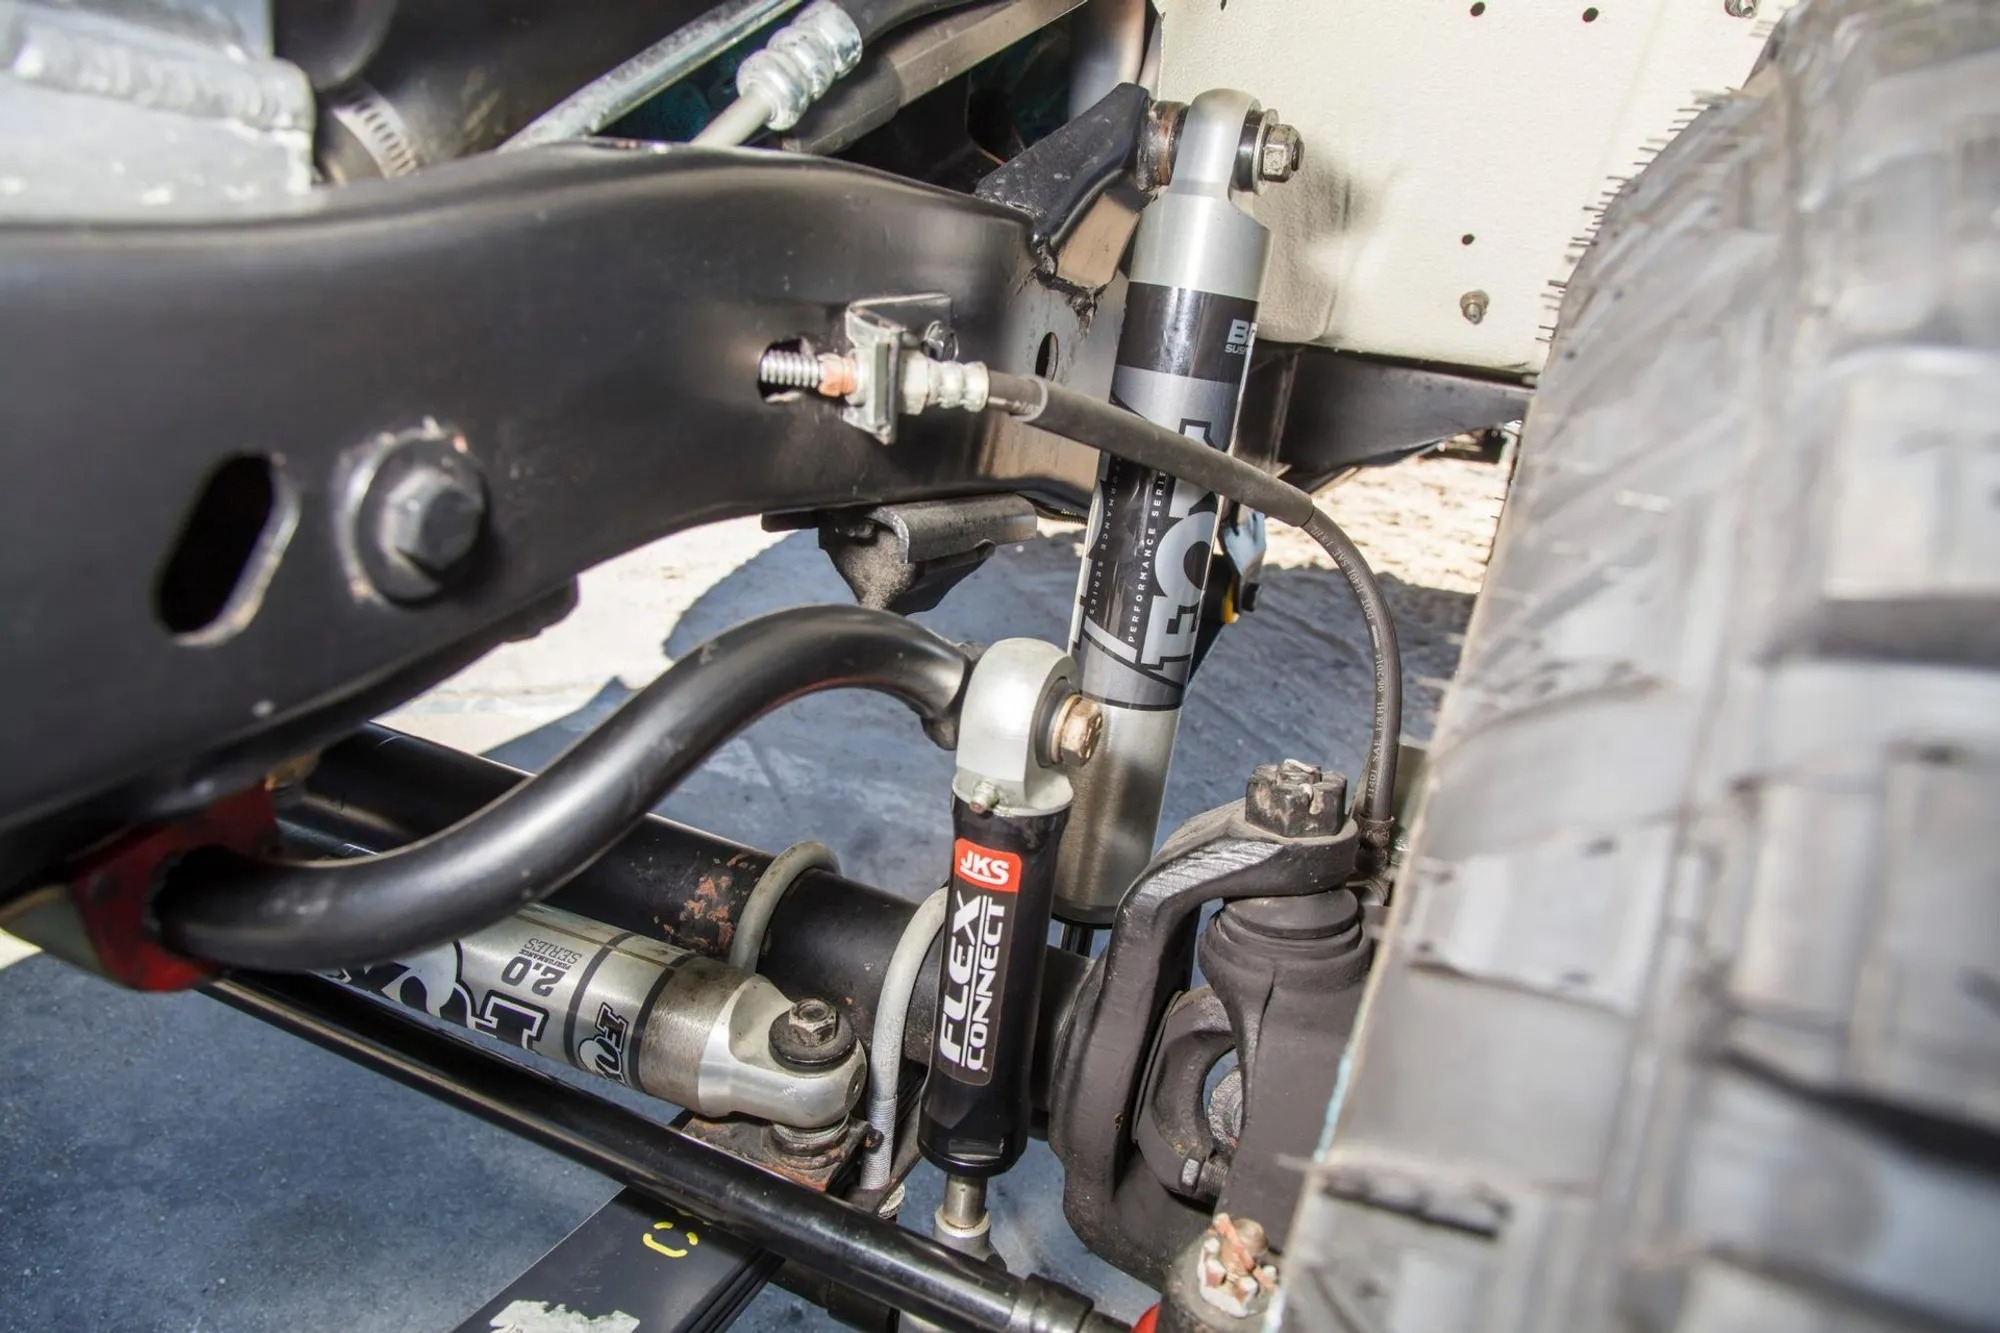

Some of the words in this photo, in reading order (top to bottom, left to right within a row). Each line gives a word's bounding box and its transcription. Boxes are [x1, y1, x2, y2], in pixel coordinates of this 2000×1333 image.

[1127, 527, 1156, 643] PERFORMANCE
[1151, 471, 1167, 517] SERIE
[1332, 548, 1349, 567] SAE
[1089, 560, 1104, 615] SERIES
[1361, 597, 1376, 620] DOT
[960, 849, 1010, 886] JKS
[518, 949, 572, 971] PERFORMANCE
[523, 937, 583, 965] SERIES
[501, 956, 567, 997] 2.0
[940, 888, 982, 1064] FLEX
[966, 896, 1006, 1071] CONNECT
